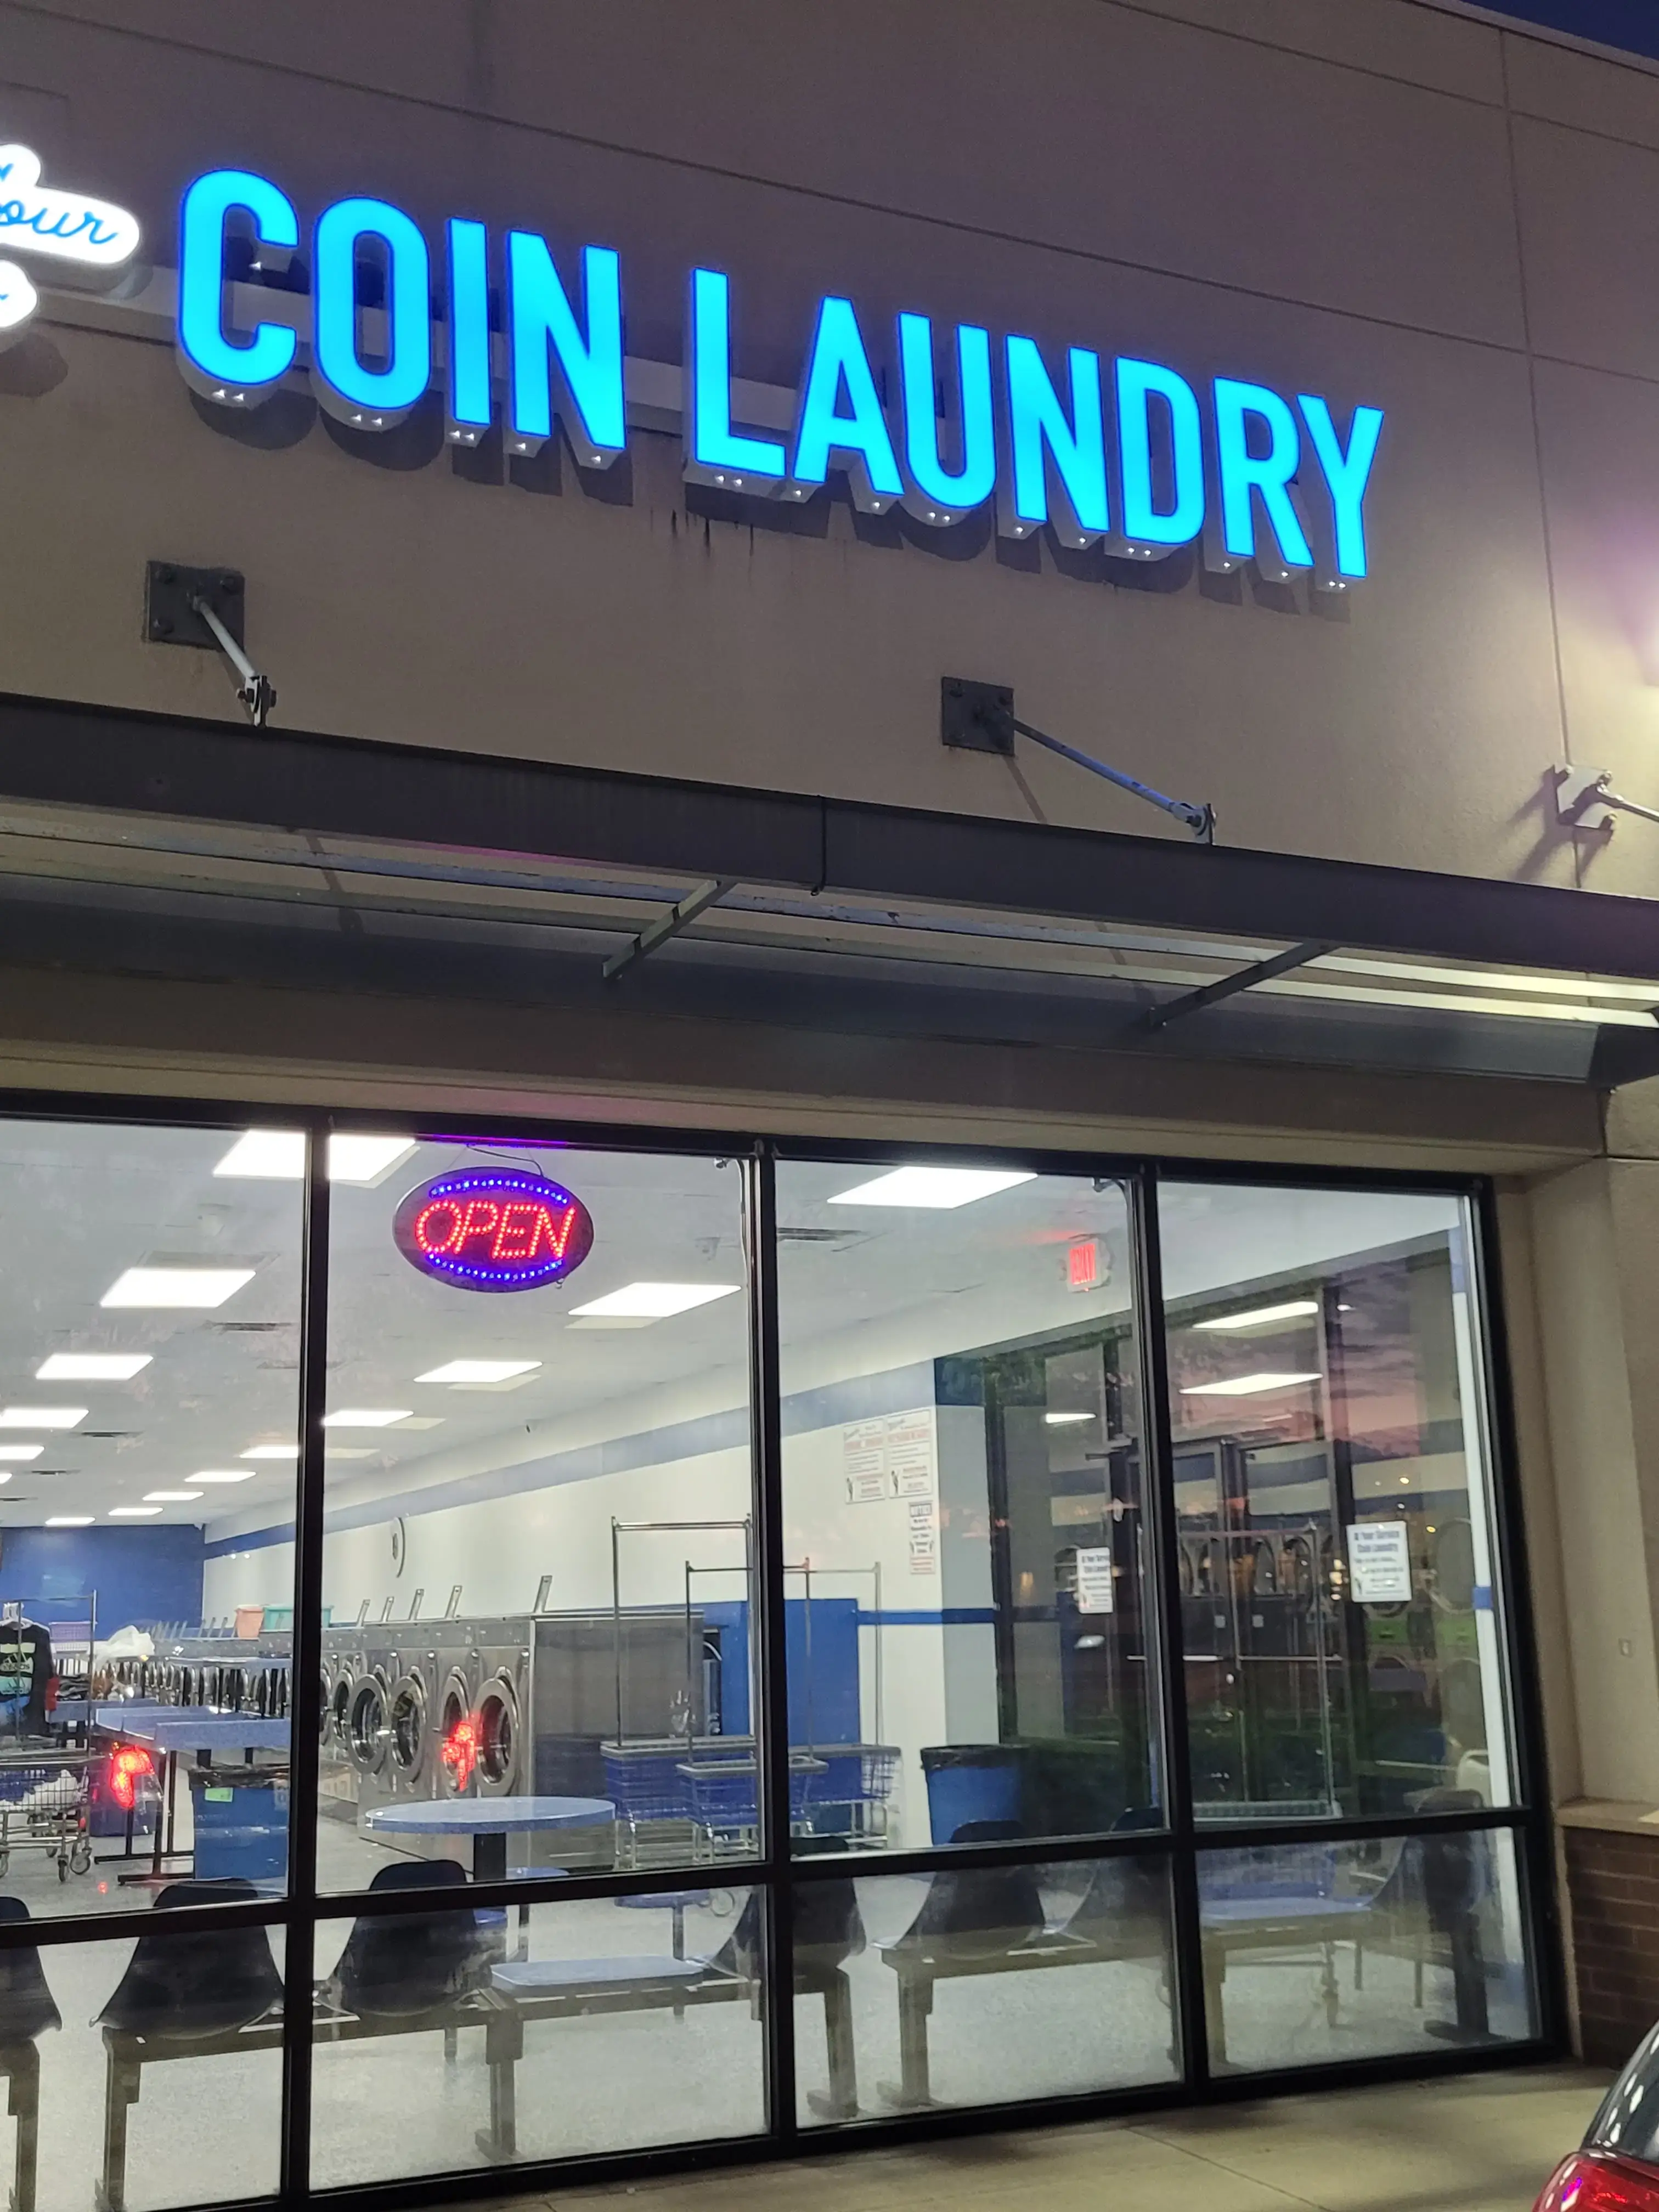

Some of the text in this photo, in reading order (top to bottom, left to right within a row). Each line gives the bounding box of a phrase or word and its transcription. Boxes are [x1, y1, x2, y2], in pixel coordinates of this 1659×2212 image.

[0, 184, 117, 245] our
[175, 167, 1386, 579] COIN LAUNDRY
[414, 1199, 577, 1260] OPEN
